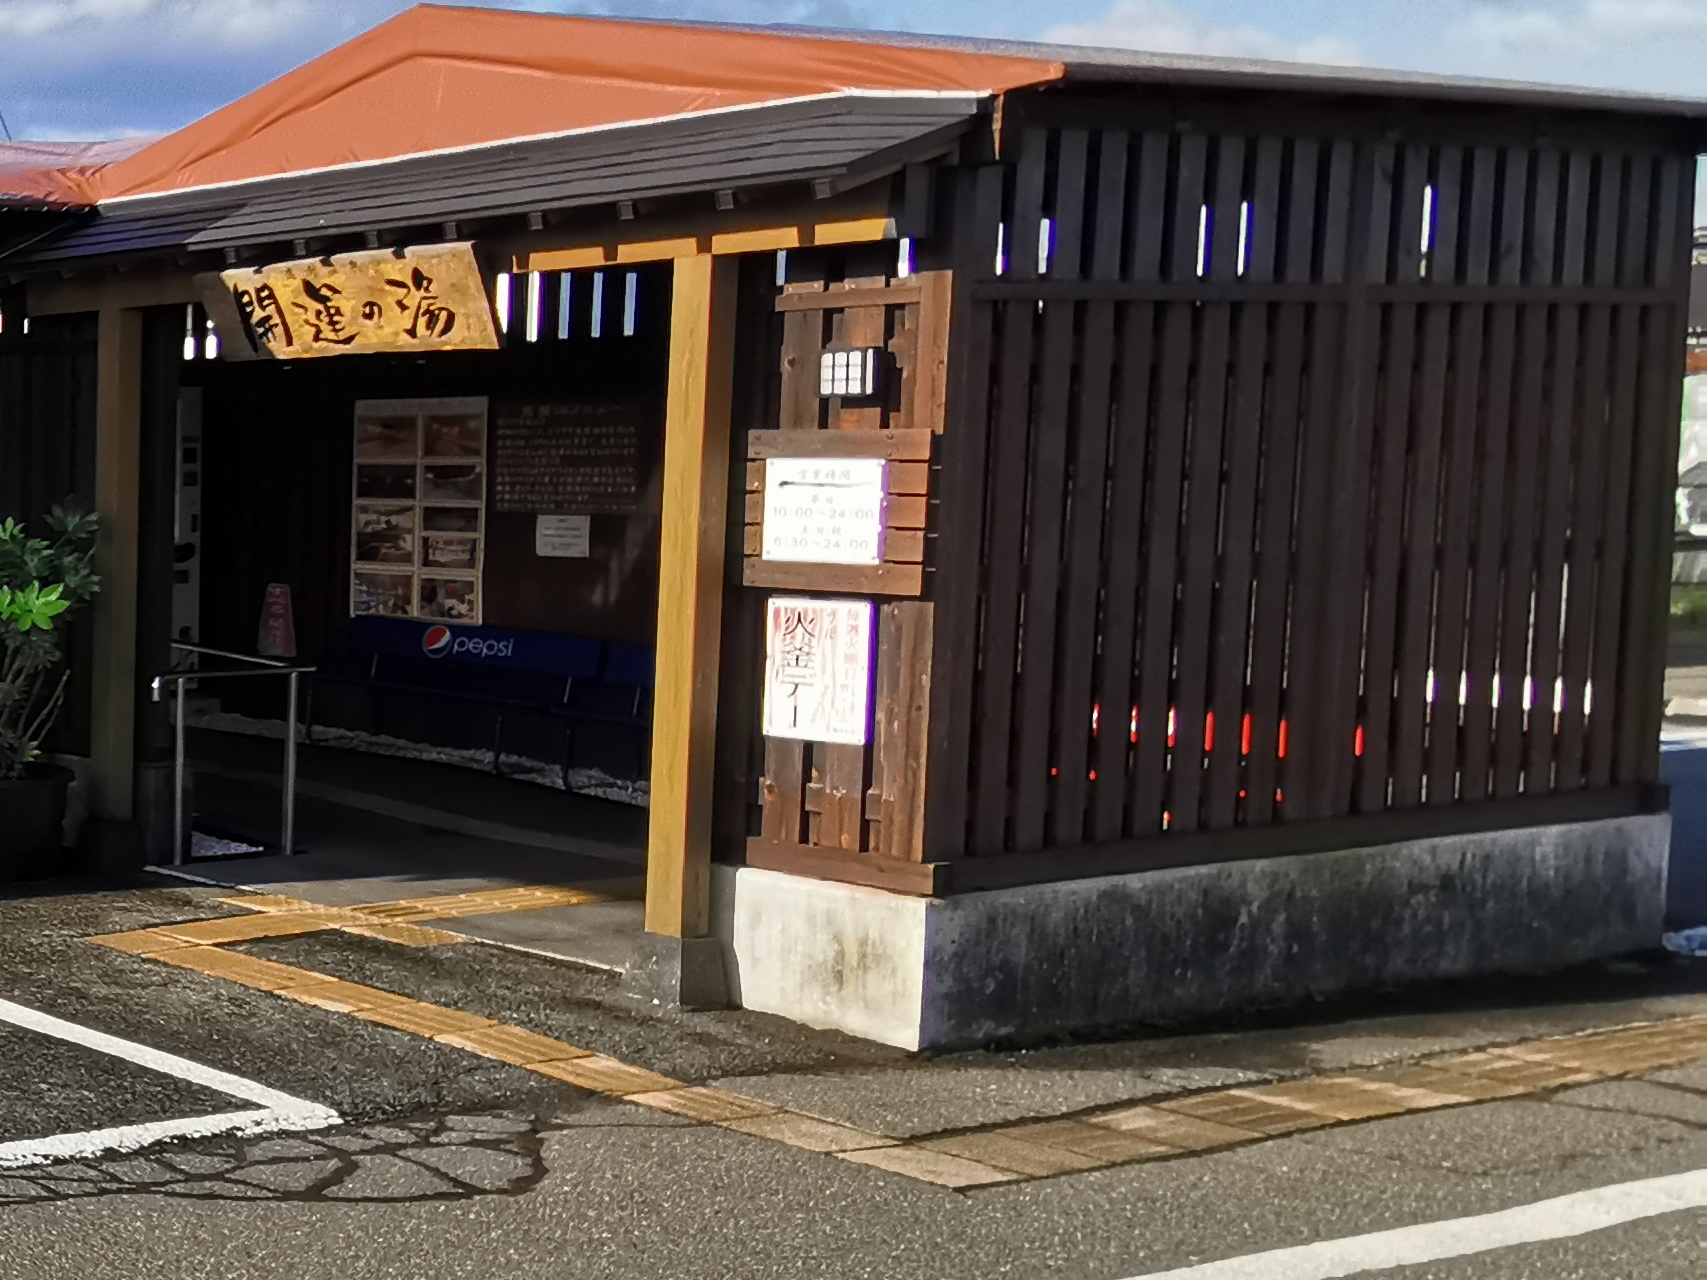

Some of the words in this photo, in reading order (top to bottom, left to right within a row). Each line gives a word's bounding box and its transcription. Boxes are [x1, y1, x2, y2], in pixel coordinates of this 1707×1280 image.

[233, 266, 456, 353] 開運の湯
[452, 636, 515, 658] pepsi
